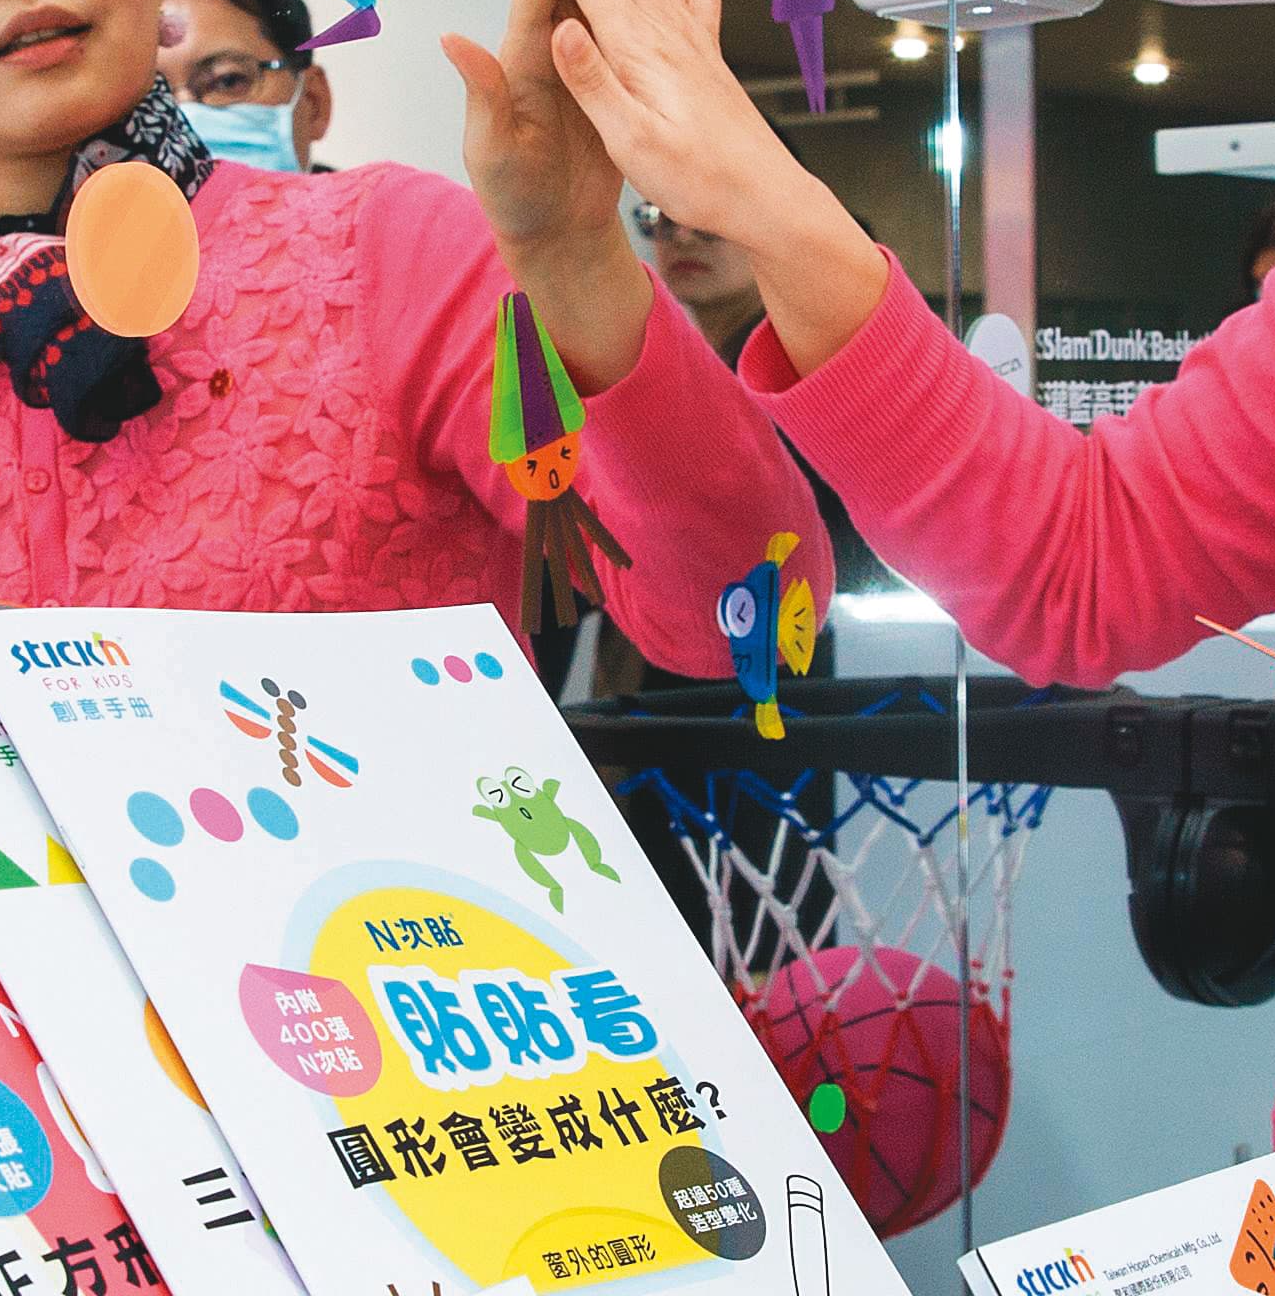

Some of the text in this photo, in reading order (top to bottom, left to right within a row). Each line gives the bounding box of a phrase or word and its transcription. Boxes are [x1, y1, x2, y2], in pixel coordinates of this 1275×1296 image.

[1039, 326, 1093, 360] Slam
[1095, 328, 1147, 361] Dunk
[41, 674, 134, 692] FOR KIDS
[364, 915, 465, 953] N次貼
[279, 1015, 355, 1046] 400張
[382, 969, 659, 1074] 貼貼看
[297, 1045, 364, 1076] N次貼
[672, 1176, 748, 1211] 超過50種
[686, 1201, 758, 1235] 造型變化
[1103, 1266, 1130, 1281] Taiwan
[1127, 1259, 1151, 1274] Hopax
[1149, 1246, 1184, 1265] Chemicals
